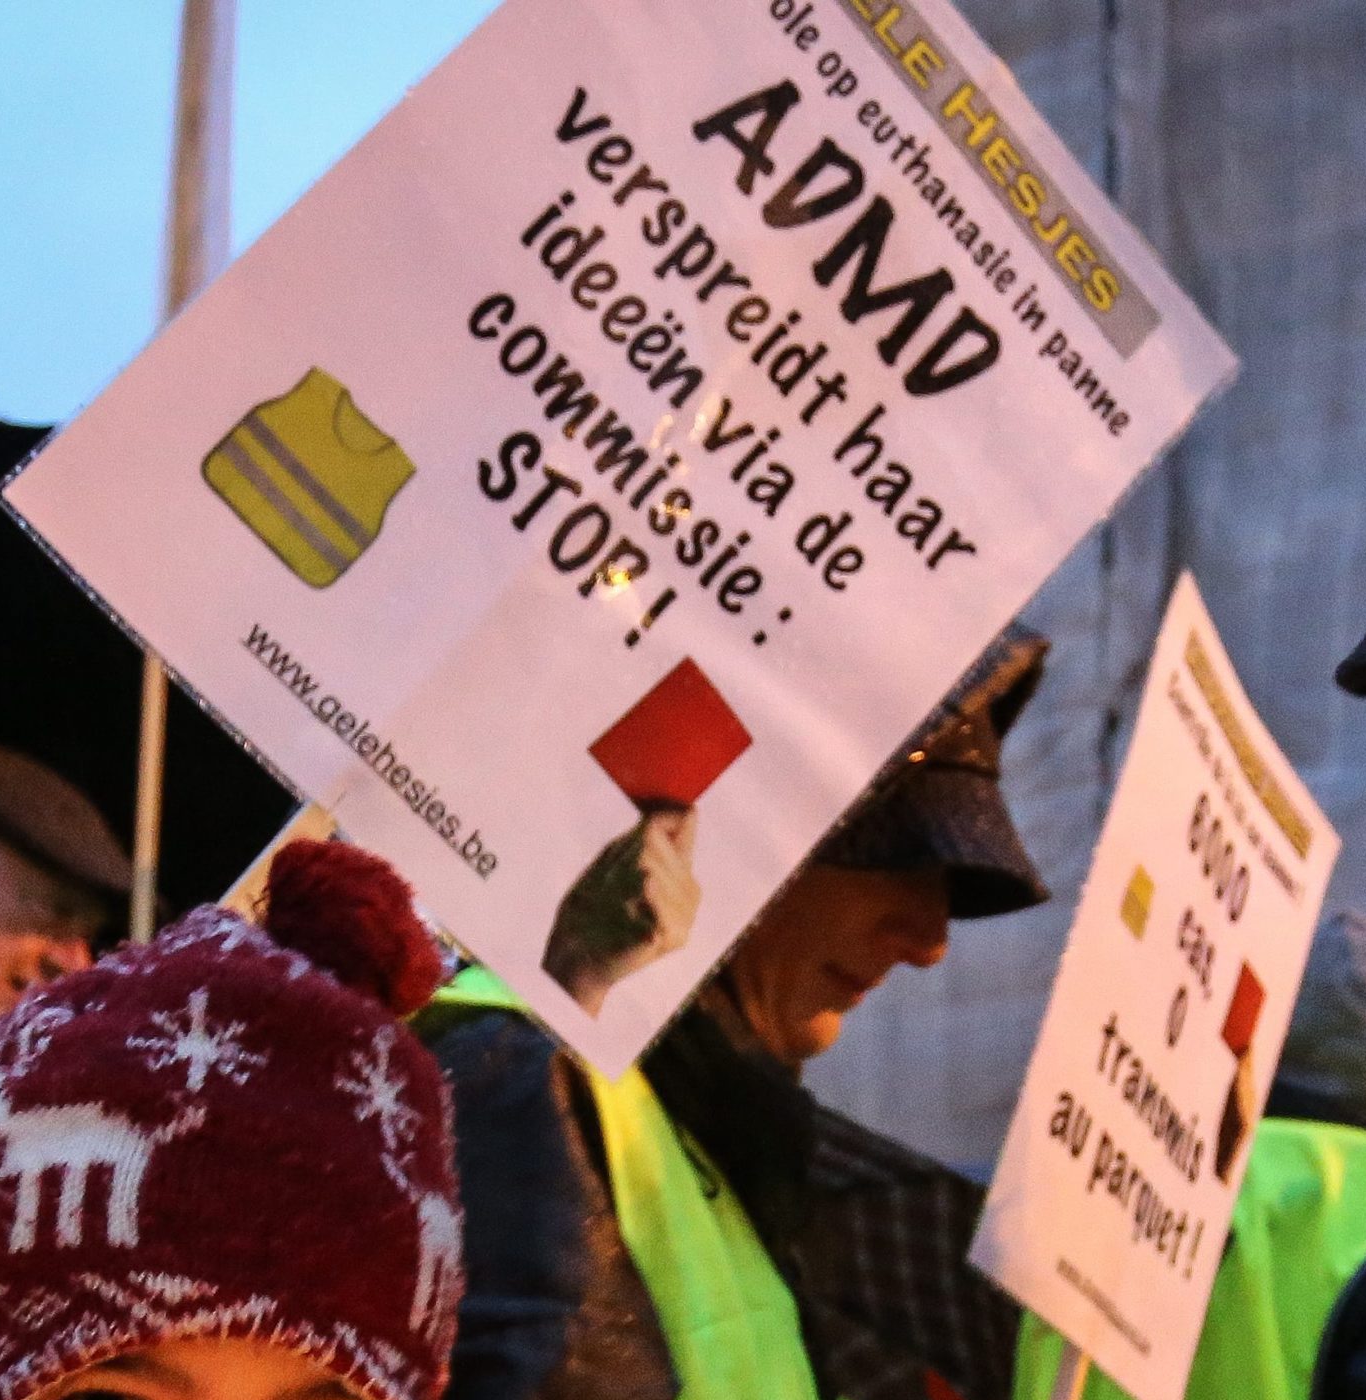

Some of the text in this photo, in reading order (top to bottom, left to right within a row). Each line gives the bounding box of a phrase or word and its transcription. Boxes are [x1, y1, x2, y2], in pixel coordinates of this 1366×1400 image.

[555, 87, 978, 571] verspreidt haar
[692, 79, 1003, 398] ADMD
[817, 51, 858, 97] op
[856, 100, 1019, 295] euthanasie
[1011, 285, 1051, 336] in
[1039, 330, 1131, 437] panne
[943, 82, 1122, 314] HESJES
[520, 190, 866, 591] ideeën via de
[242, 622, 498, 880] www.gelehesjes.be
[1048, 1089, 1093, 1160] au
[1096, 1010, 1204, 1184] transmis
